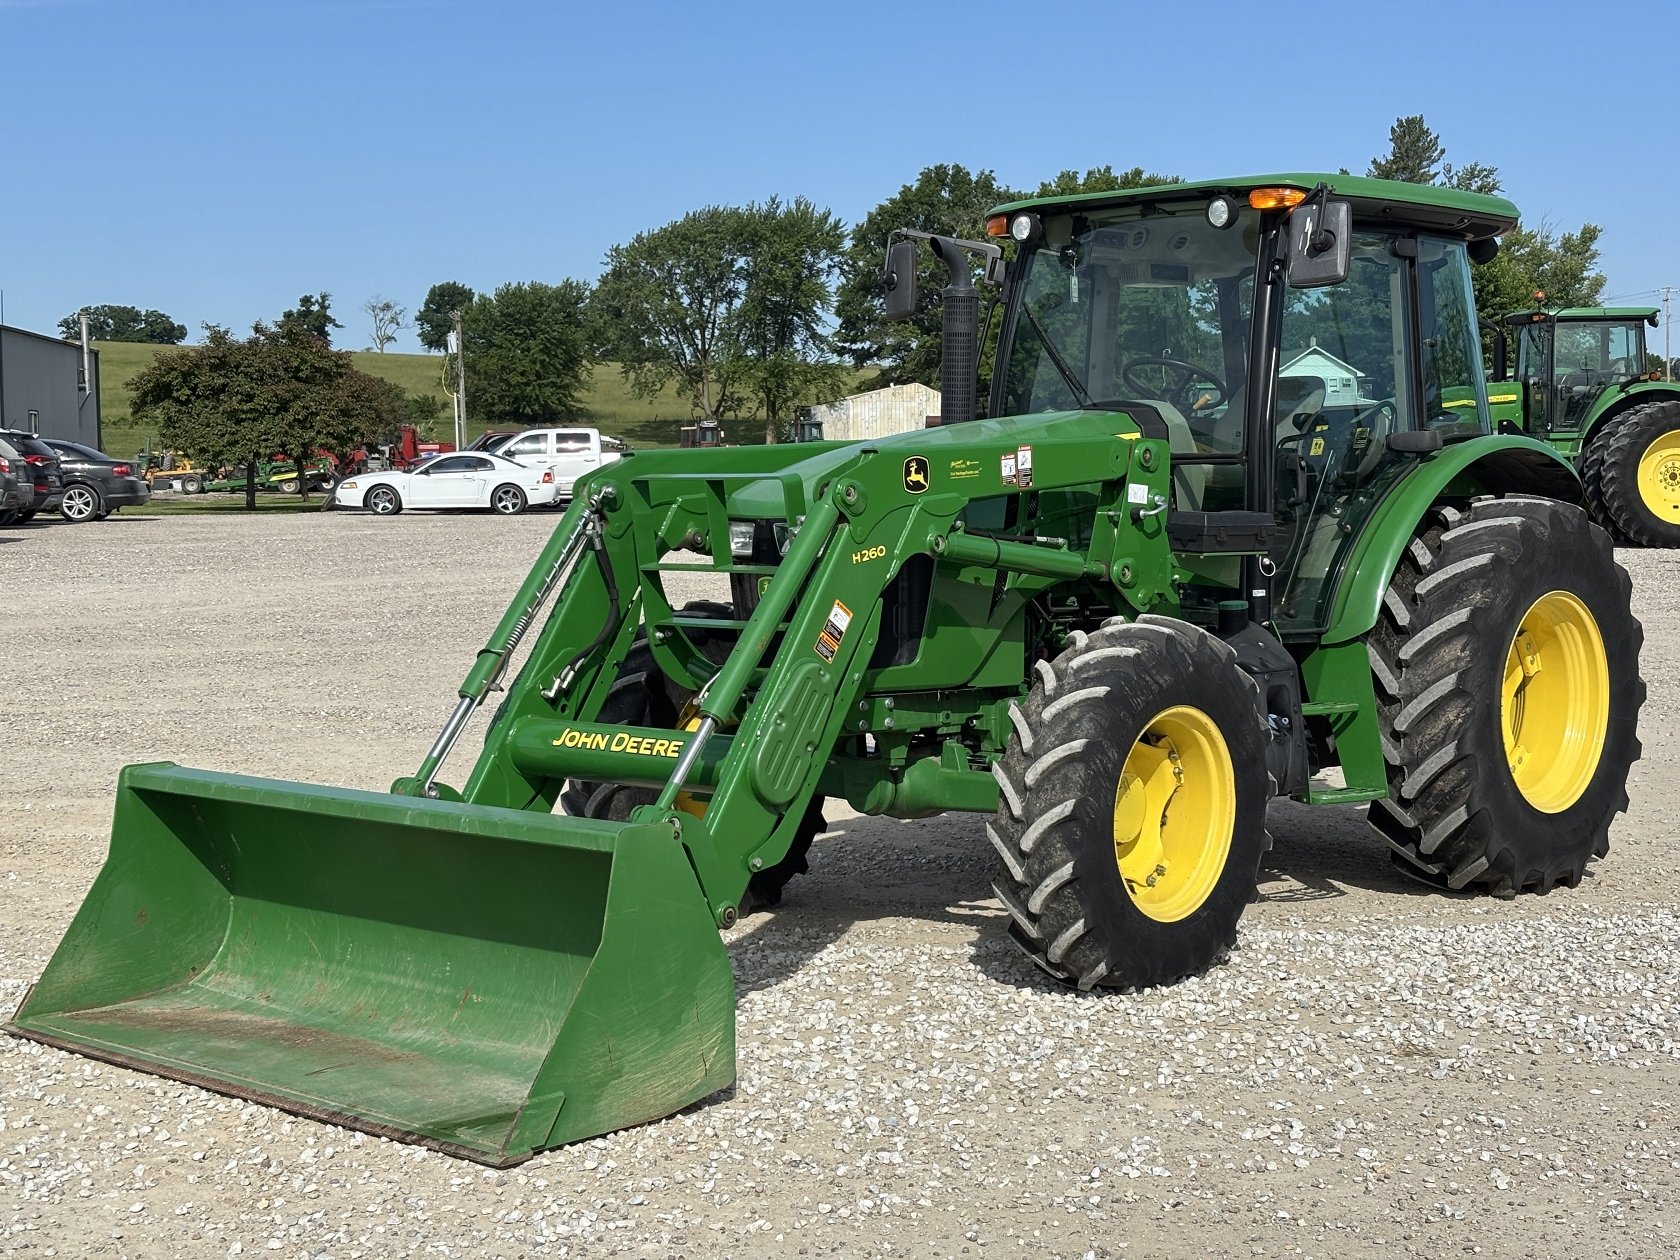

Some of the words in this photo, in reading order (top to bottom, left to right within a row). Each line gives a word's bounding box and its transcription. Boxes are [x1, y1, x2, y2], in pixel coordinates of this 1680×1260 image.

[852, 545, 886, 564] H260
[552, 727, 611, 751] JOHN
[609, 732, 685, 758] DEERE
